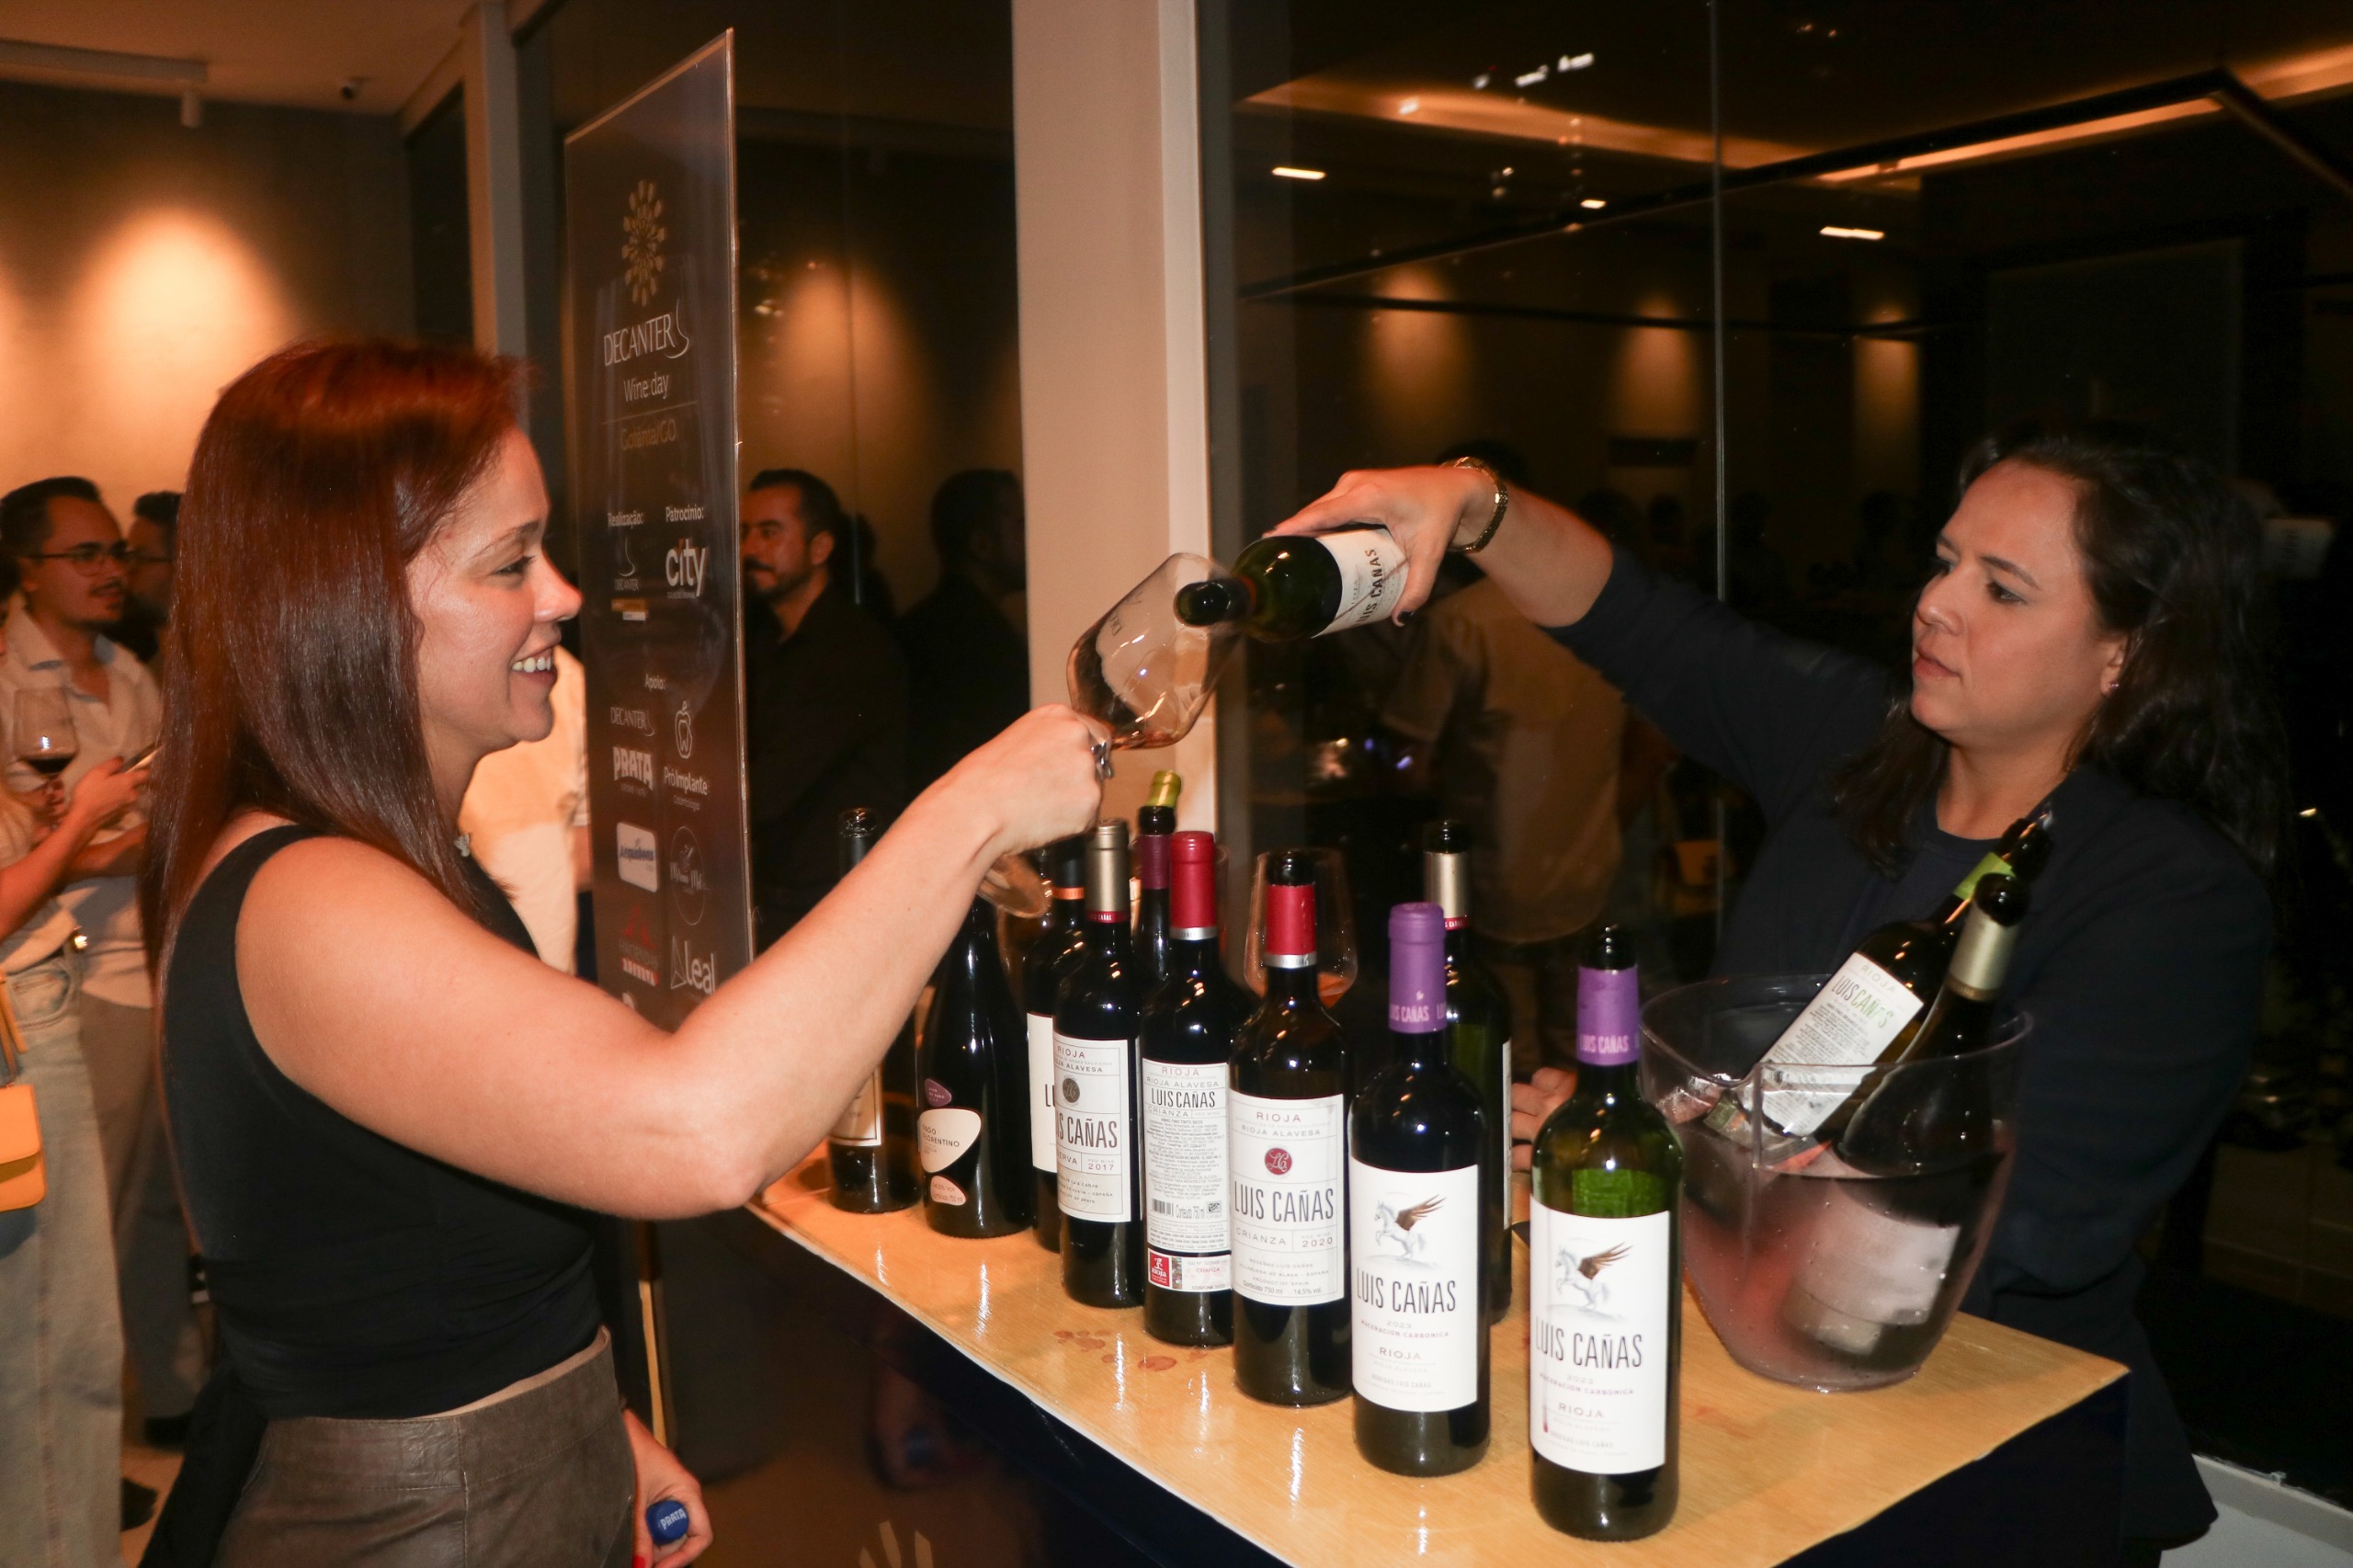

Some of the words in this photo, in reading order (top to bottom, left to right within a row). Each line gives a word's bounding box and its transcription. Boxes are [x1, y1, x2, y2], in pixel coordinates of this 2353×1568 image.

[604, 313, 676, 367] DECANTER
[623, 378, 649, 403] Wine
[650, 371, 670, 400] day
[665, 537, 709, 597] city
[660, 588, 687, 611] PRATA
[612, 746, 654, 791] PRATA
[1832, 975, 1859, 1001] LUIS
[1860, 965, 1895, 993] RIOJA
[1057, 1046, 1086, 1059] RIOJA
[1066, 1063, 1103, 1073] ALAVESA
[1162, 1066, 1200, 1076] RIOJA
[1146, 1076, 1170, 1087] RIOJA
[1152, 1087, 1174, 1108] LUIS
[1176, 1090, 1216, 1108] CAÑAS
[1147, 1106, 1188, 1118] CRIANZA
[1256, 1111, 1302, 1123] RIOJA
[1067, 1116, 1118, 1149] CAÑAS
[1242, 1124, 1267, 1135] RIOJA
[1272, 1129, 1321, 1137] ALAVESA
[1088, 1163, 1115, 1171] 2017
[1233, 1180, 1265, 1220] LUIS
[1273, 1187, 1335, 1223] CAÑAS
[1236, 1227, 1287, 1245] CRIANZA
[1302, 1236, 1334, 1248] 2020
[1356, 1267, 1384, 1309] LUIS
[1392, 1279, 1457, 1314] CAÑAS
[1386, 1320, 1412, 1329] 2023
[1534, 1315, 1565, 1362] LUIS
[1573, 1333, 1643, 1369] CAÑAS
[1379, 1346, 1422, 1360] RIOJA
[1558, 1403, 1604, 1418] RIOJA
